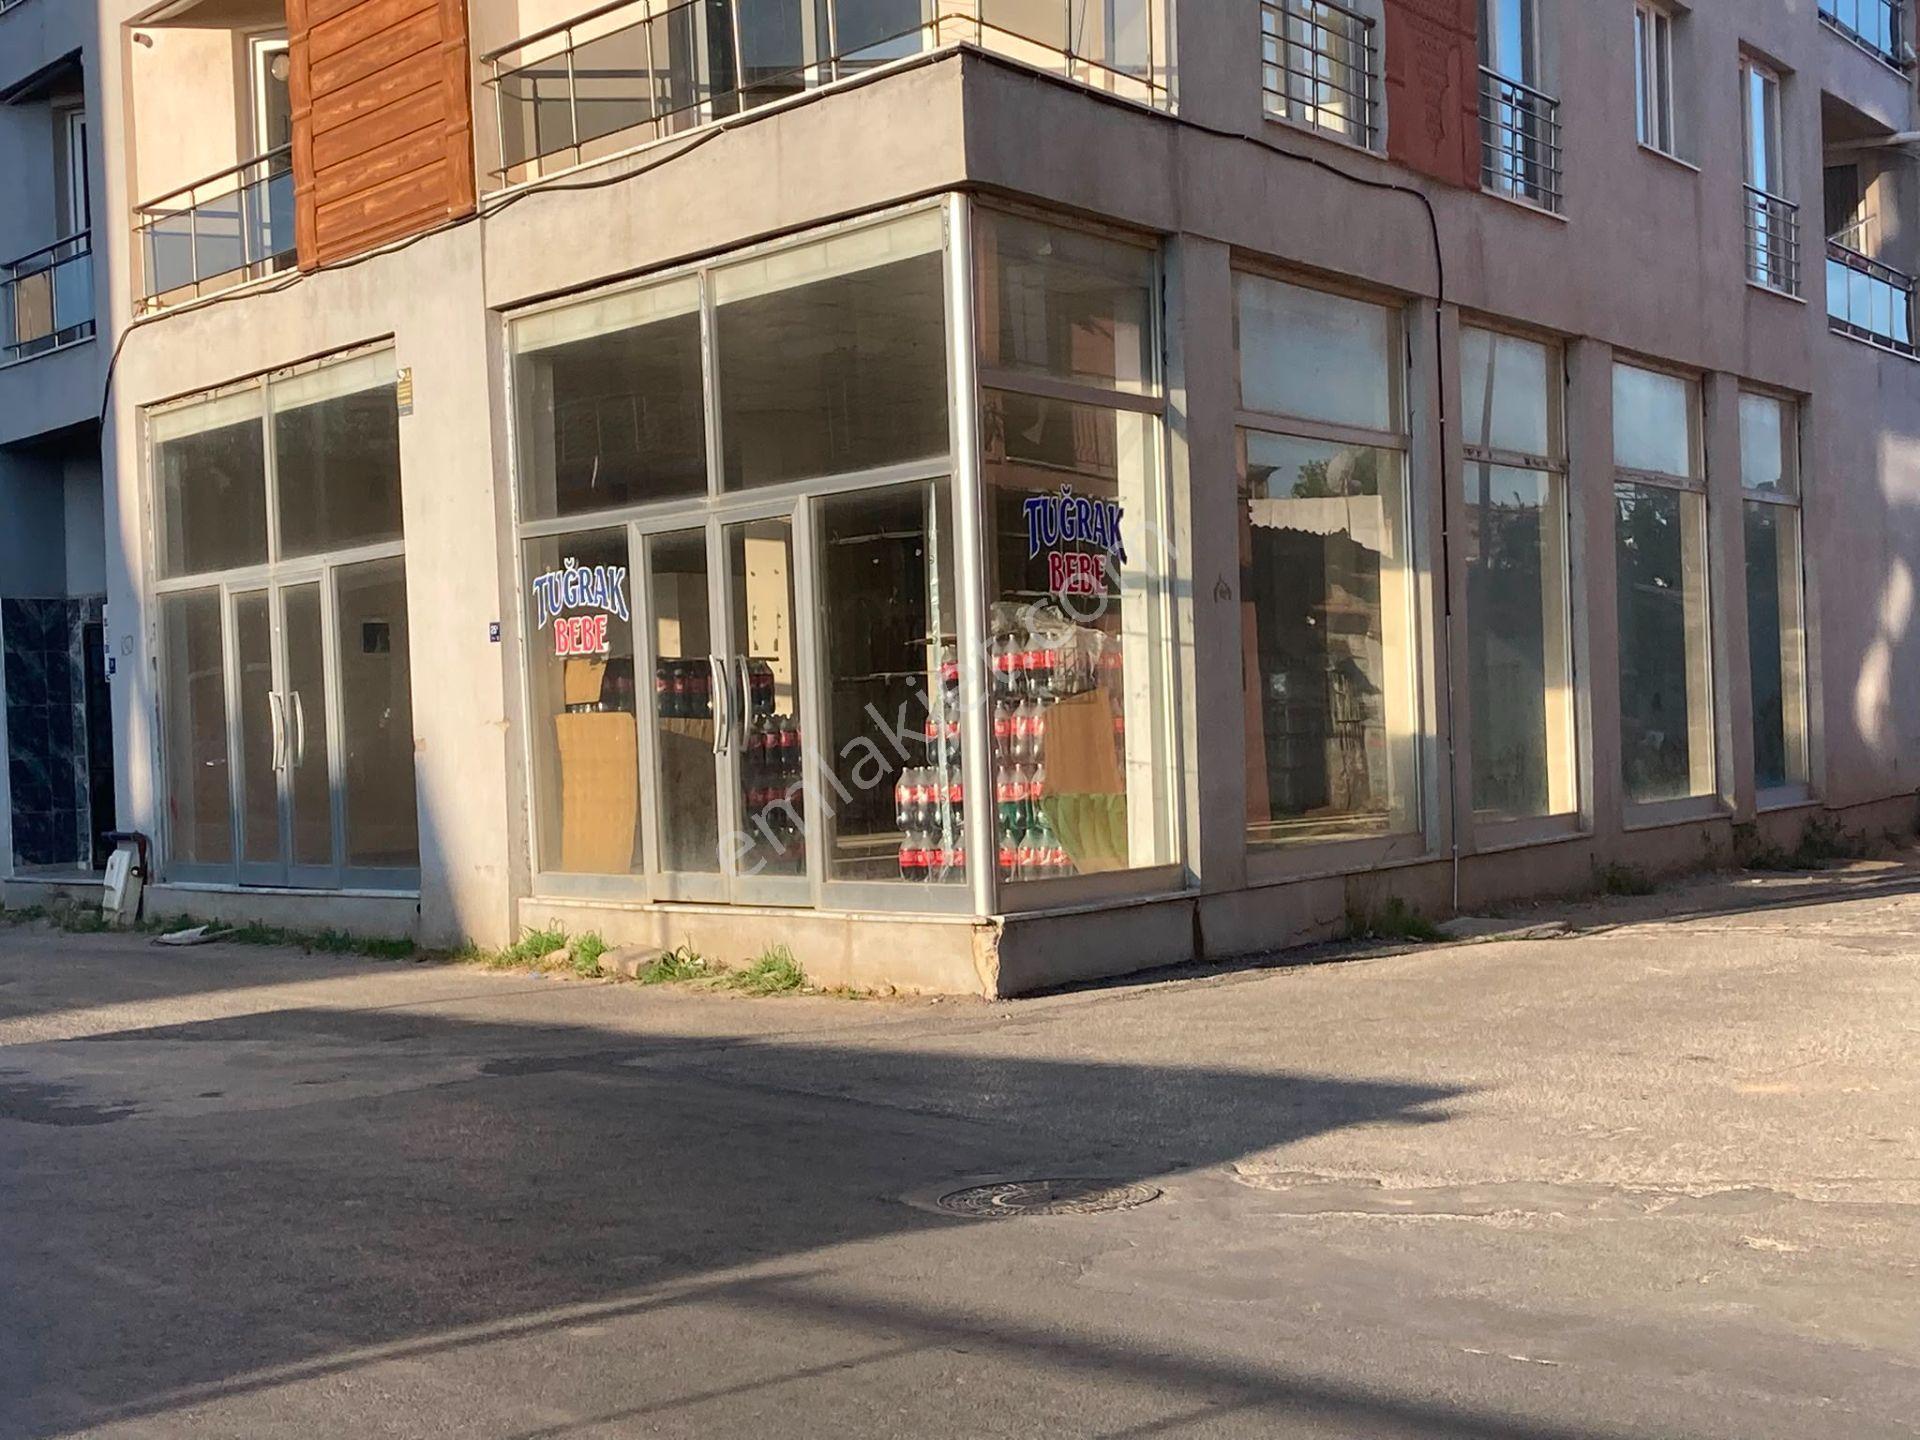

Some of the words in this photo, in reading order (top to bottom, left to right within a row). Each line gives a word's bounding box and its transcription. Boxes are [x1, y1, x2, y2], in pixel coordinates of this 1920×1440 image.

[1023, 484, 1127, 565] TUĞRAK
[532, 557, 629, 630] TUĞRAK
[1048, 551, 1108, 595] BEBE
[554, 614, 609, 655] BEBE
